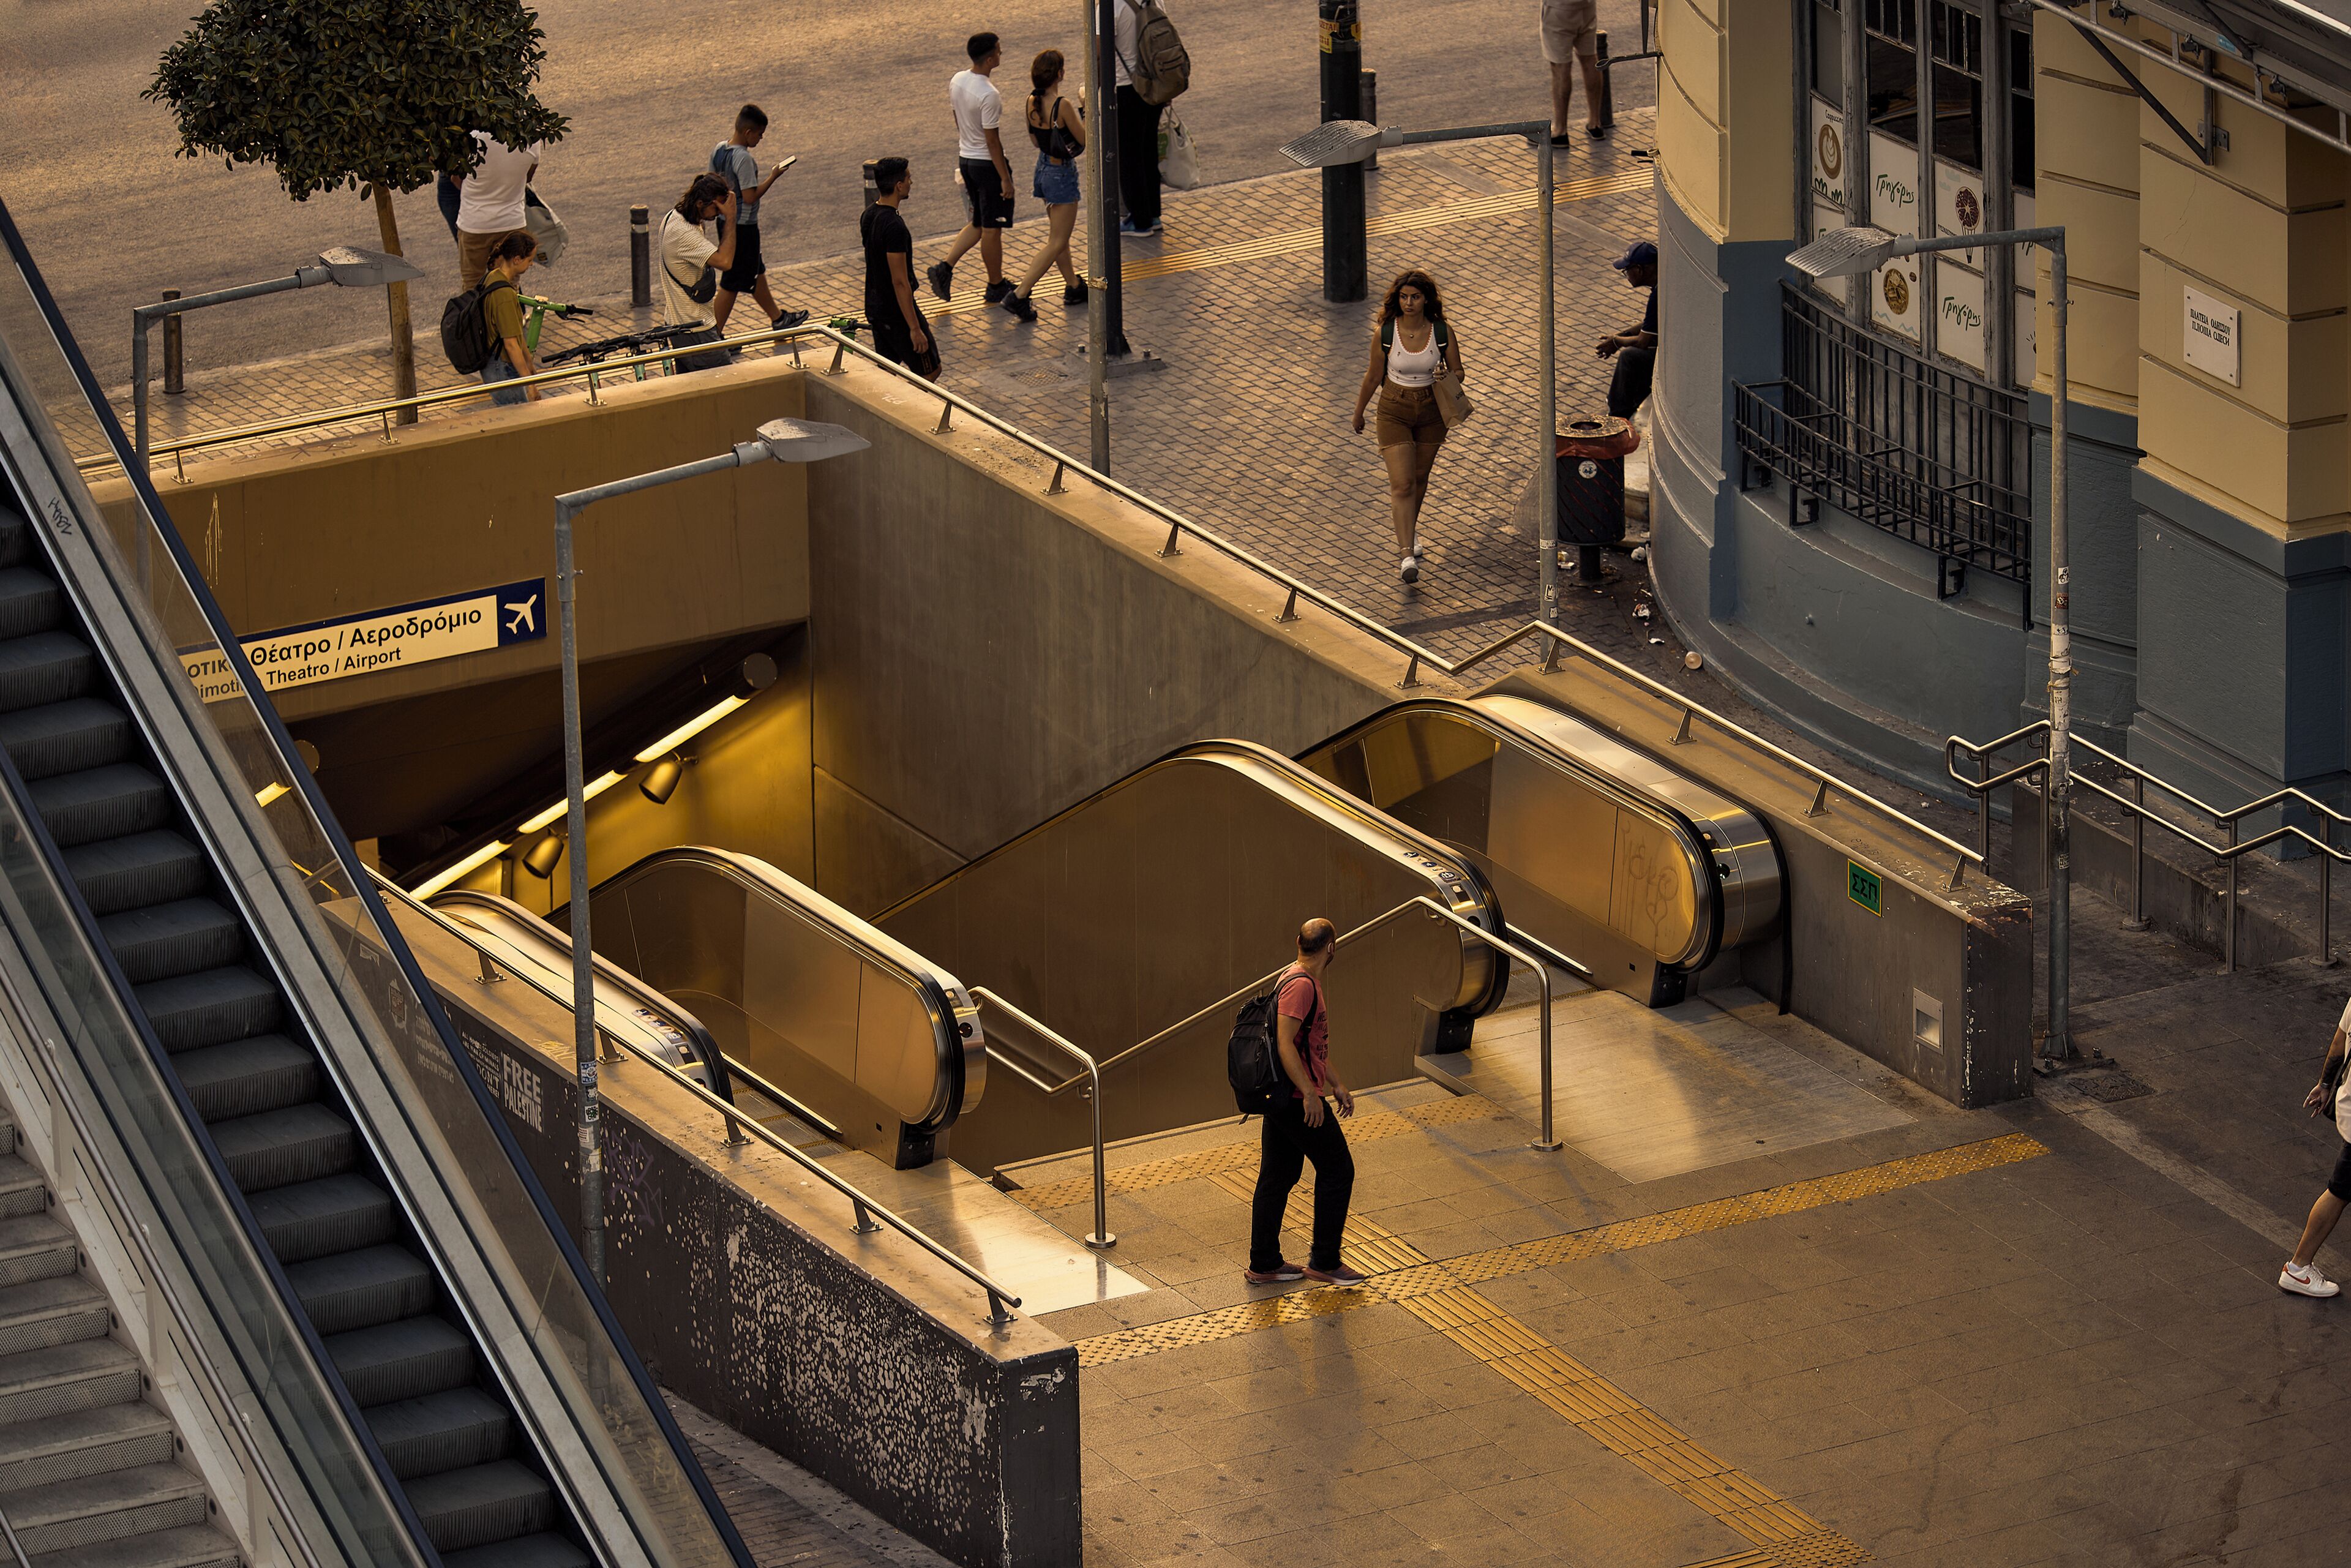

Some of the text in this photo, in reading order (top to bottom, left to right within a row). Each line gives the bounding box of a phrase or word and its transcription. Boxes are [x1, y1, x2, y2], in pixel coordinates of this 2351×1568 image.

[1875, 174, 1914, 208] Γρηγόρης
[1942, 296, 1981, 331] Γρηγόρης
[2190, 308, 2231, 336] ΠΛΑΤΕΙΑ ΟΔΗΣΣΟΥ
[250, 639, 331, 666] Θέατρο
[337, 630, 344, 651] /
[350, 610, 482, 648] Αεροδρόμιο
[266, 664, 329, 685] Theatro
[334, 658, 339, 673] /
[343, 647, 402, 671] Airport
[1852, 872, 1878, 903] ΣΣΠ
[482, 1045, 499, 1063] SOLDIERS
[503, 1052, 542, 1105] FREE
[504, 1081, 542, 1133] PALESTINE
